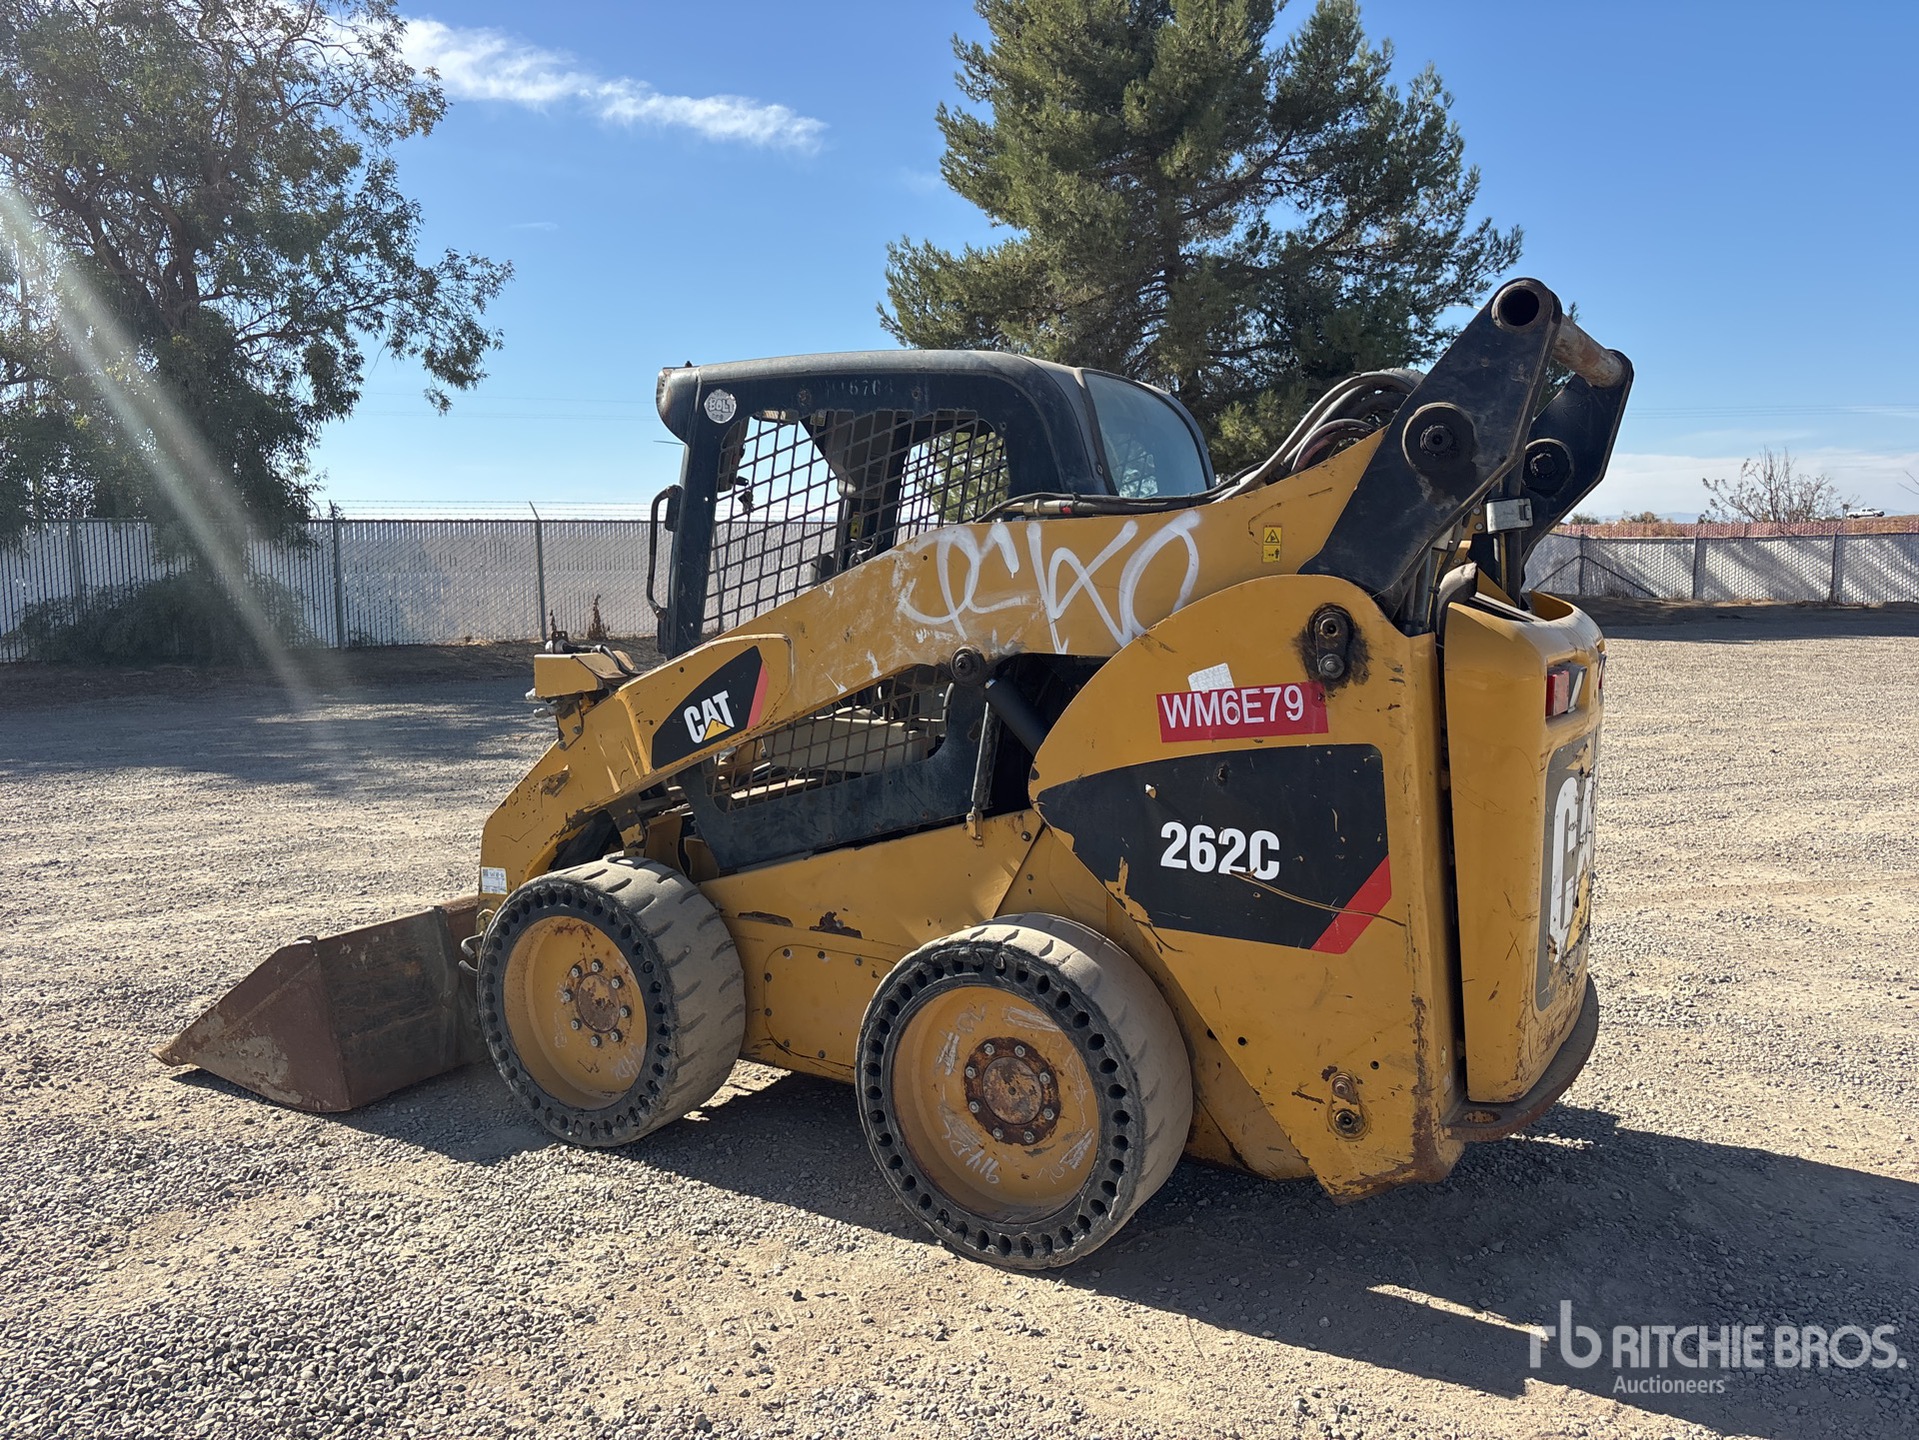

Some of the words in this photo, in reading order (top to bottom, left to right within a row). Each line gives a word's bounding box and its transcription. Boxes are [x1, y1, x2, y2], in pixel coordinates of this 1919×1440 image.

[709, 398, 734, 413] BOLT
[683, 690, 735, 744] CAT
[1161, 685, 1304, 729] WM6E79
[1160, 821, 1280, 881] 262C
